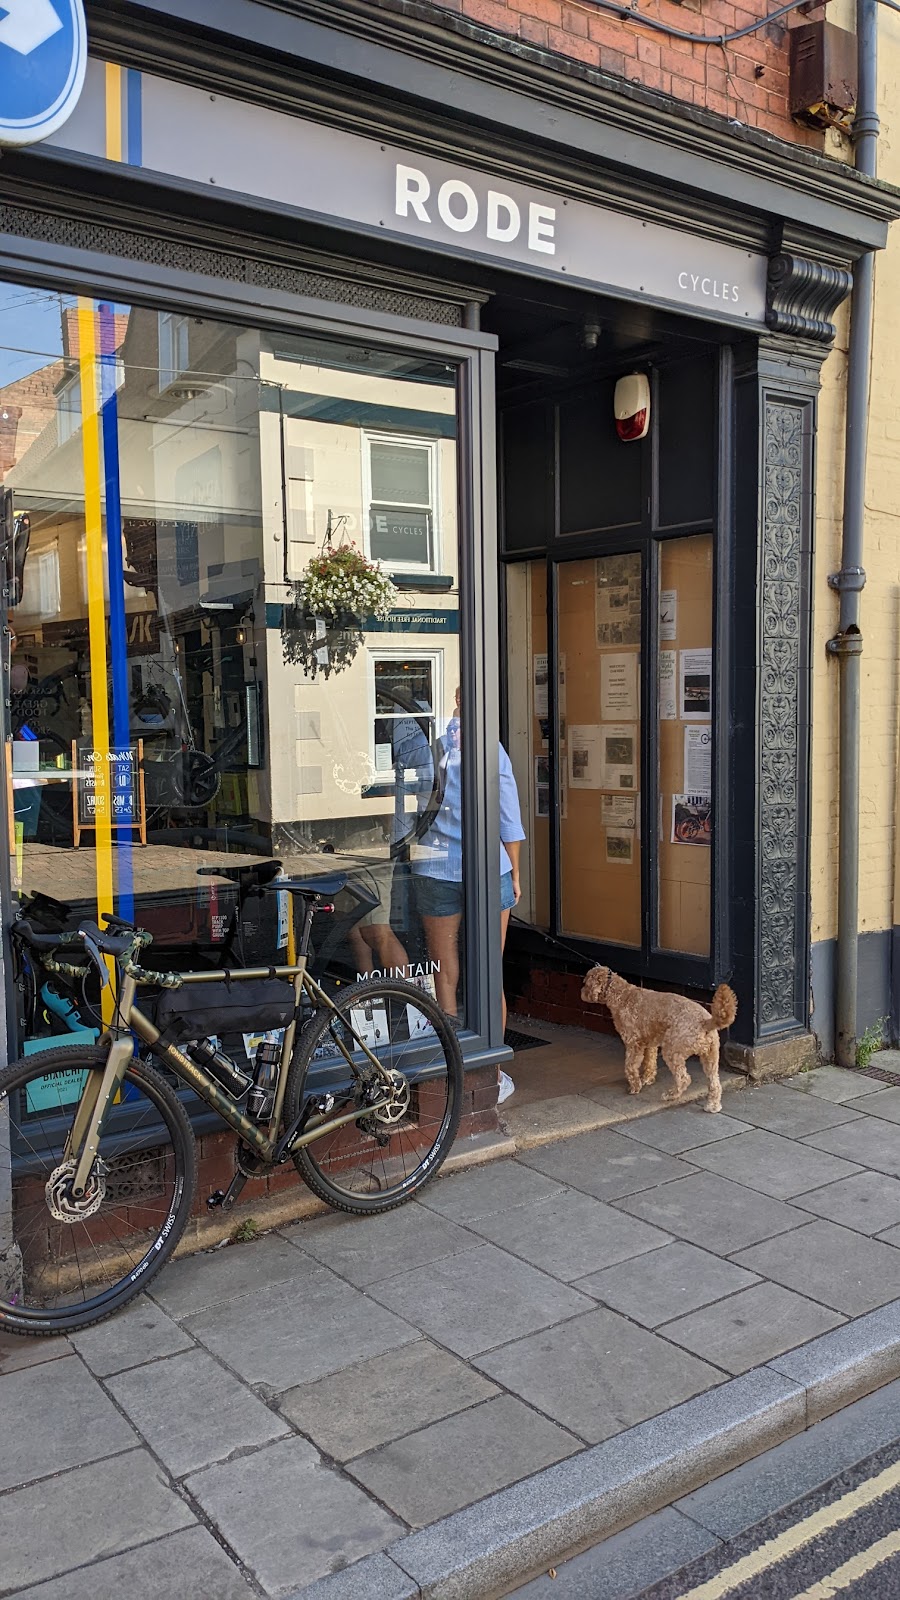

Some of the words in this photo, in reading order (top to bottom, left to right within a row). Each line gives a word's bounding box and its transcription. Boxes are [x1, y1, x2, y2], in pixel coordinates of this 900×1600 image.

[395, 163, 556, 255] RODE
[678, 272, 739, 302] CYCLES
[392, 526, 423, 536] CYCLES
[40, 1081, 63, 1090] OFFICIAL
[421, 1158, 430, 1170] DT
[428, 1142, 441, 1161] SWISS
[154, 1235, 165, 1251] DT
[161, 1213, 176, 1238] SWISS
